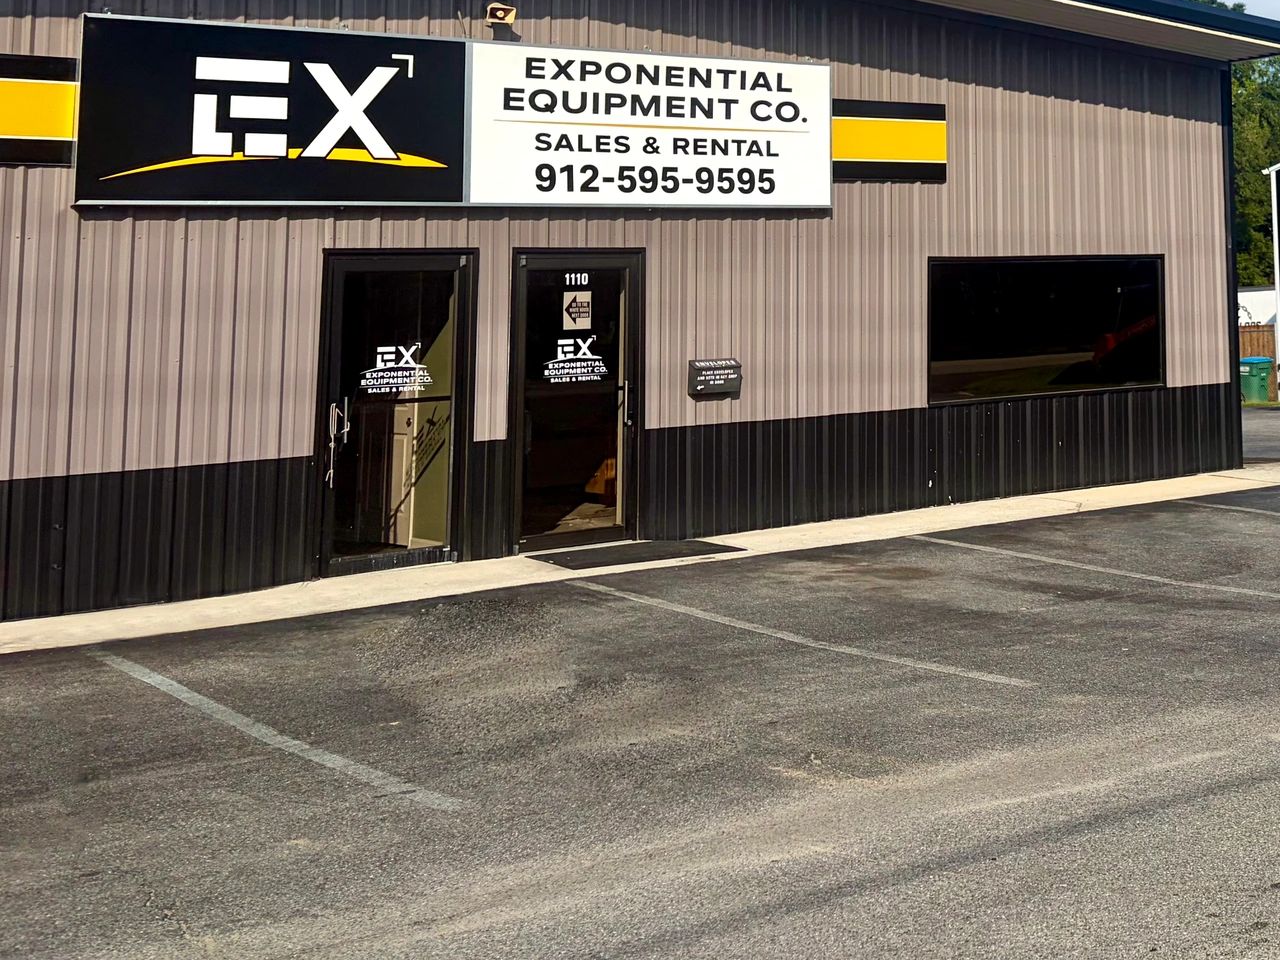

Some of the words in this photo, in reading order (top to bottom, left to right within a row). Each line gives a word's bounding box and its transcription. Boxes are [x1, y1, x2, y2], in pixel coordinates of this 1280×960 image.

[525, 57, 792, 93] EXPONENTIAL
[192, 56, 400, 160] EX
[503, 87, 739, 120] EQUIPMENT
[750, 100, 808, 123] CO.
[535, 133, 631, 154] SALES
[642, 136, 661, 155] &
[673, 137, 779, 157] RENTAL
[535, 163, 776, 194] 912-595-9595
[565, 273, 589, 286] 1110
[376, 346, 418, 368] EX
[557, 337, 594, 359] EX
[365, 370, 430, 379] EXPONENTIAL
[544, 367, 593, 376] EQUIPMENT
[548, 360, 605, 369] EXPONENTIAL
[360, 377, 416, 386] EQUIPMENT
